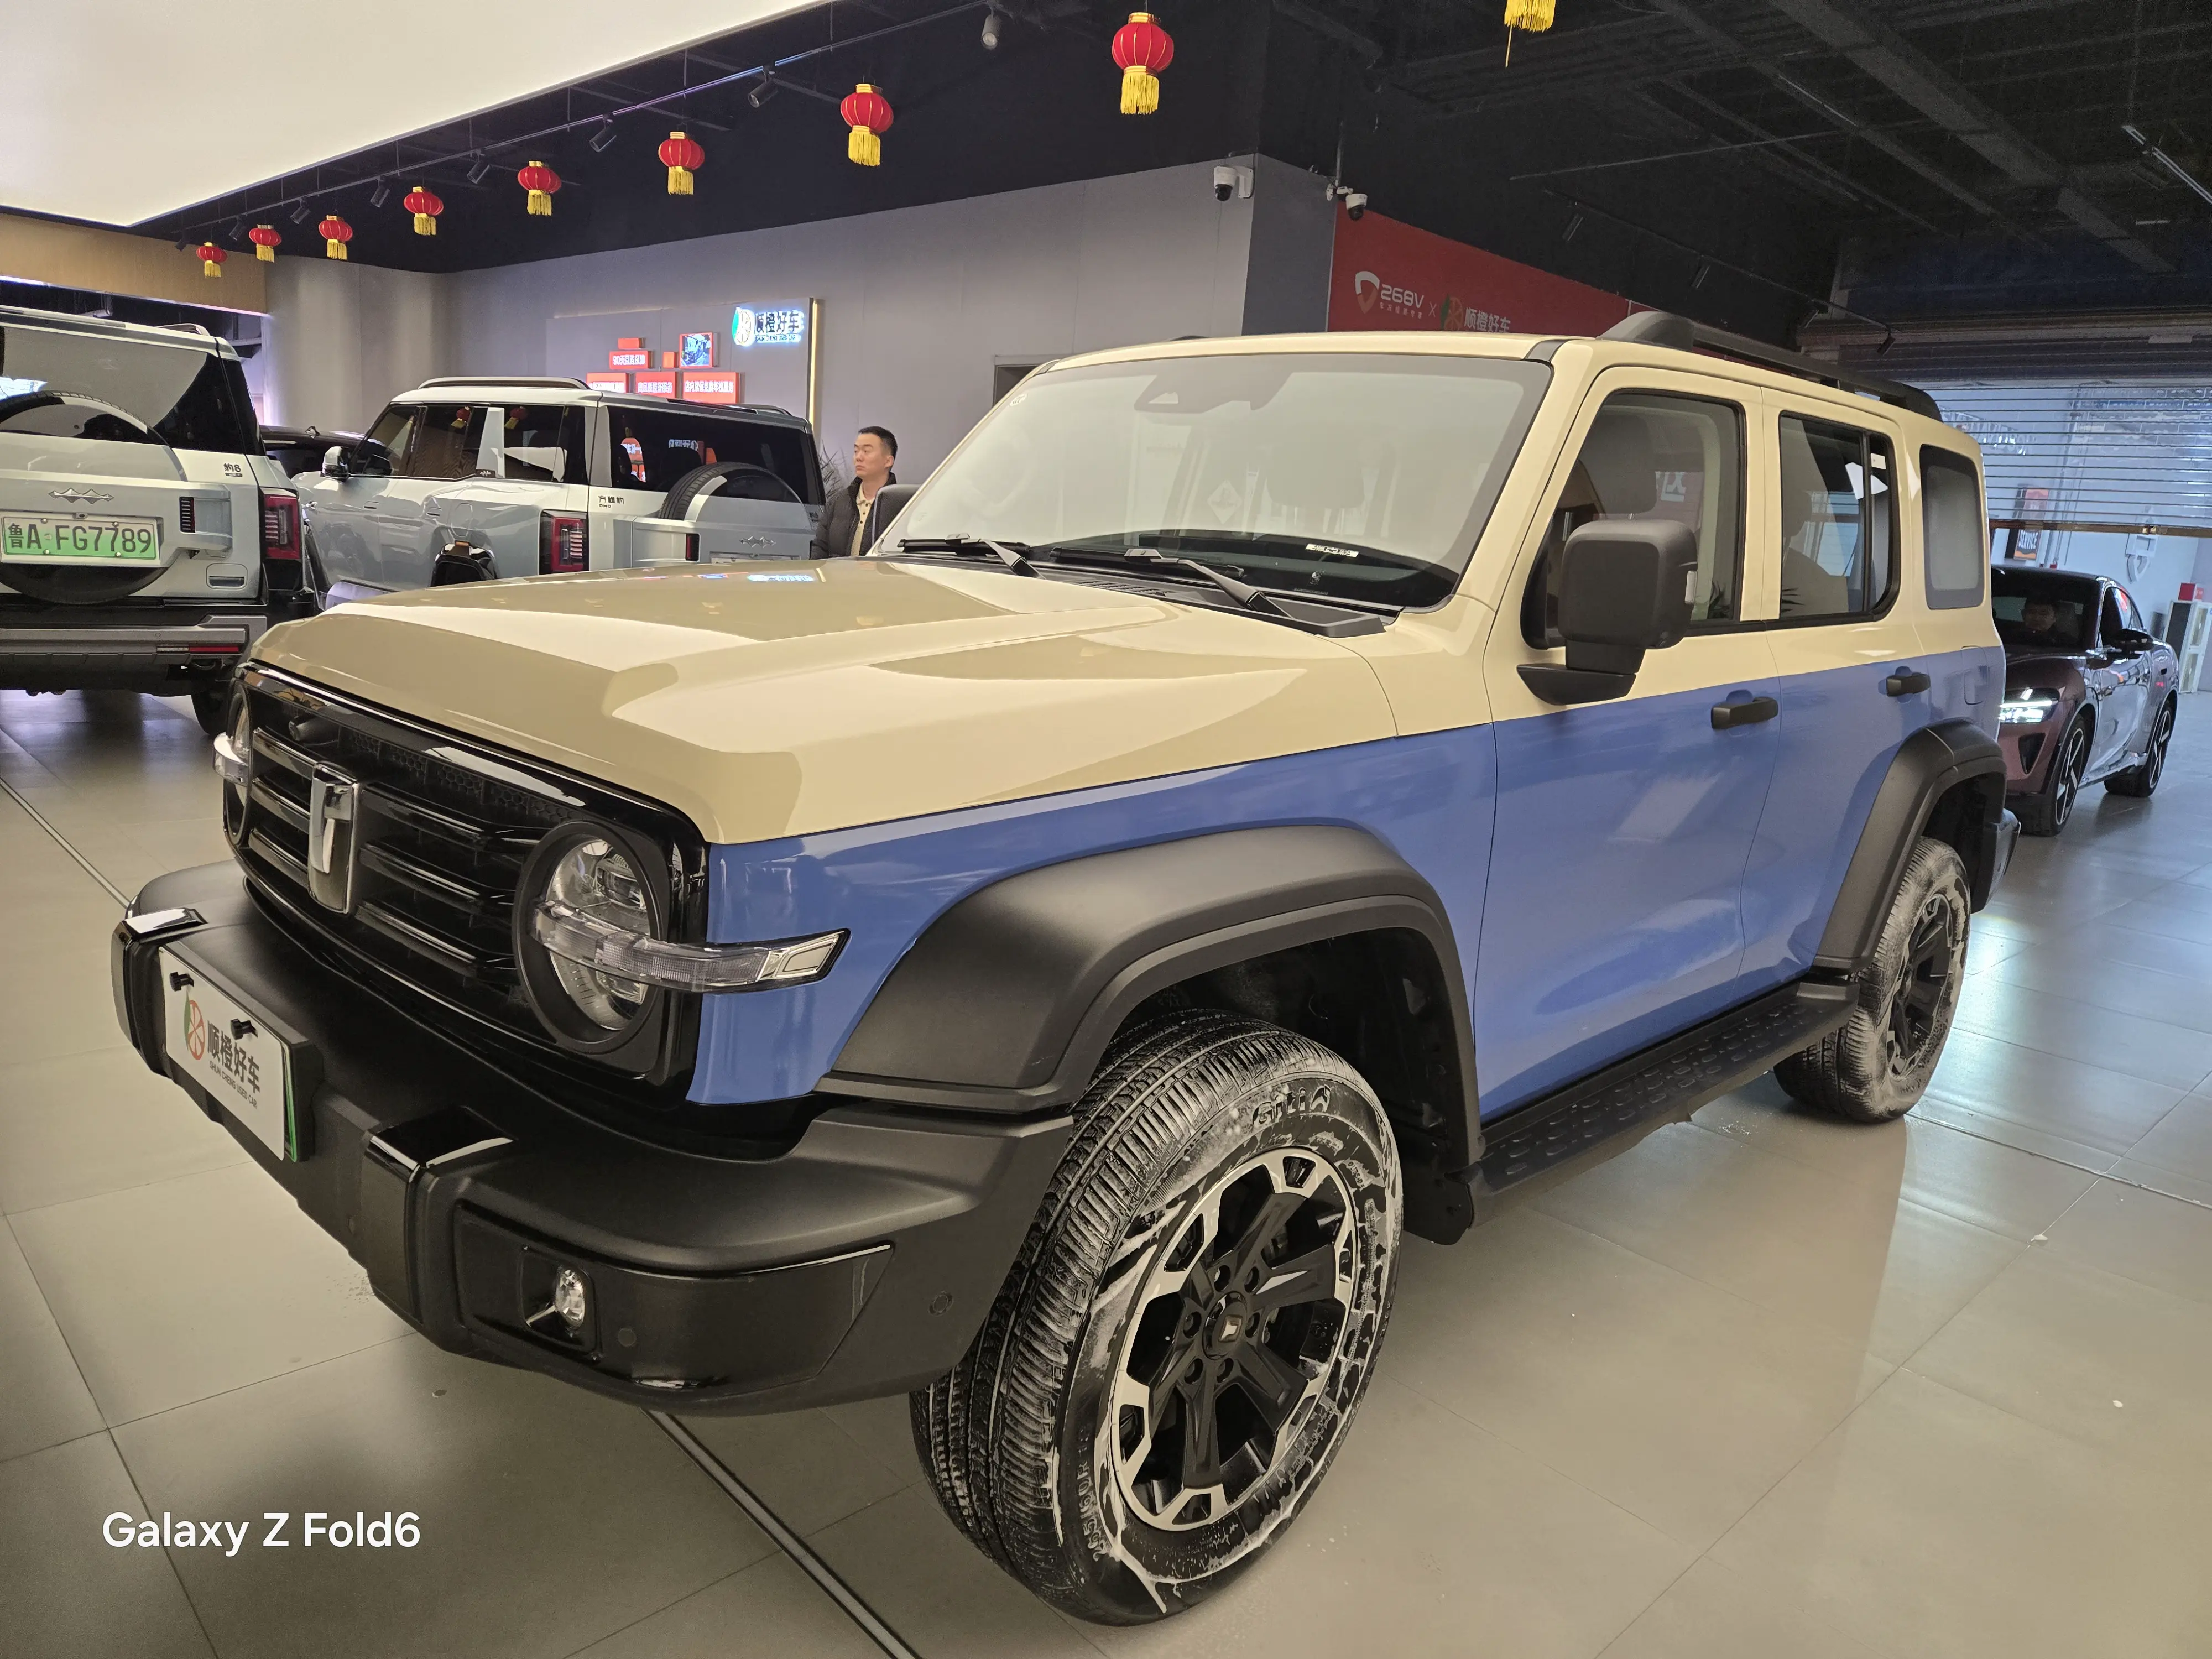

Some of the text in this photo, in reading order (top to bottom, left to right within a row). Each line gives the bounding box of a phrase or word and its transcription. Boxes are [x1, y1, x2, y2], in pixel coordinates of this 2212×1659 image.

[1380, 283, 1425, 309] 268V
[1464, 307, 1511, 332] 顺橙好车
[223, 463, 241, 472] 豹8
[2018, 529, 2038, 550] SERVICE
[208, 1020, 260, 1093] 顺橙好车
[210, 1060, 258, 1109] SHUN CHENG USED CAR
